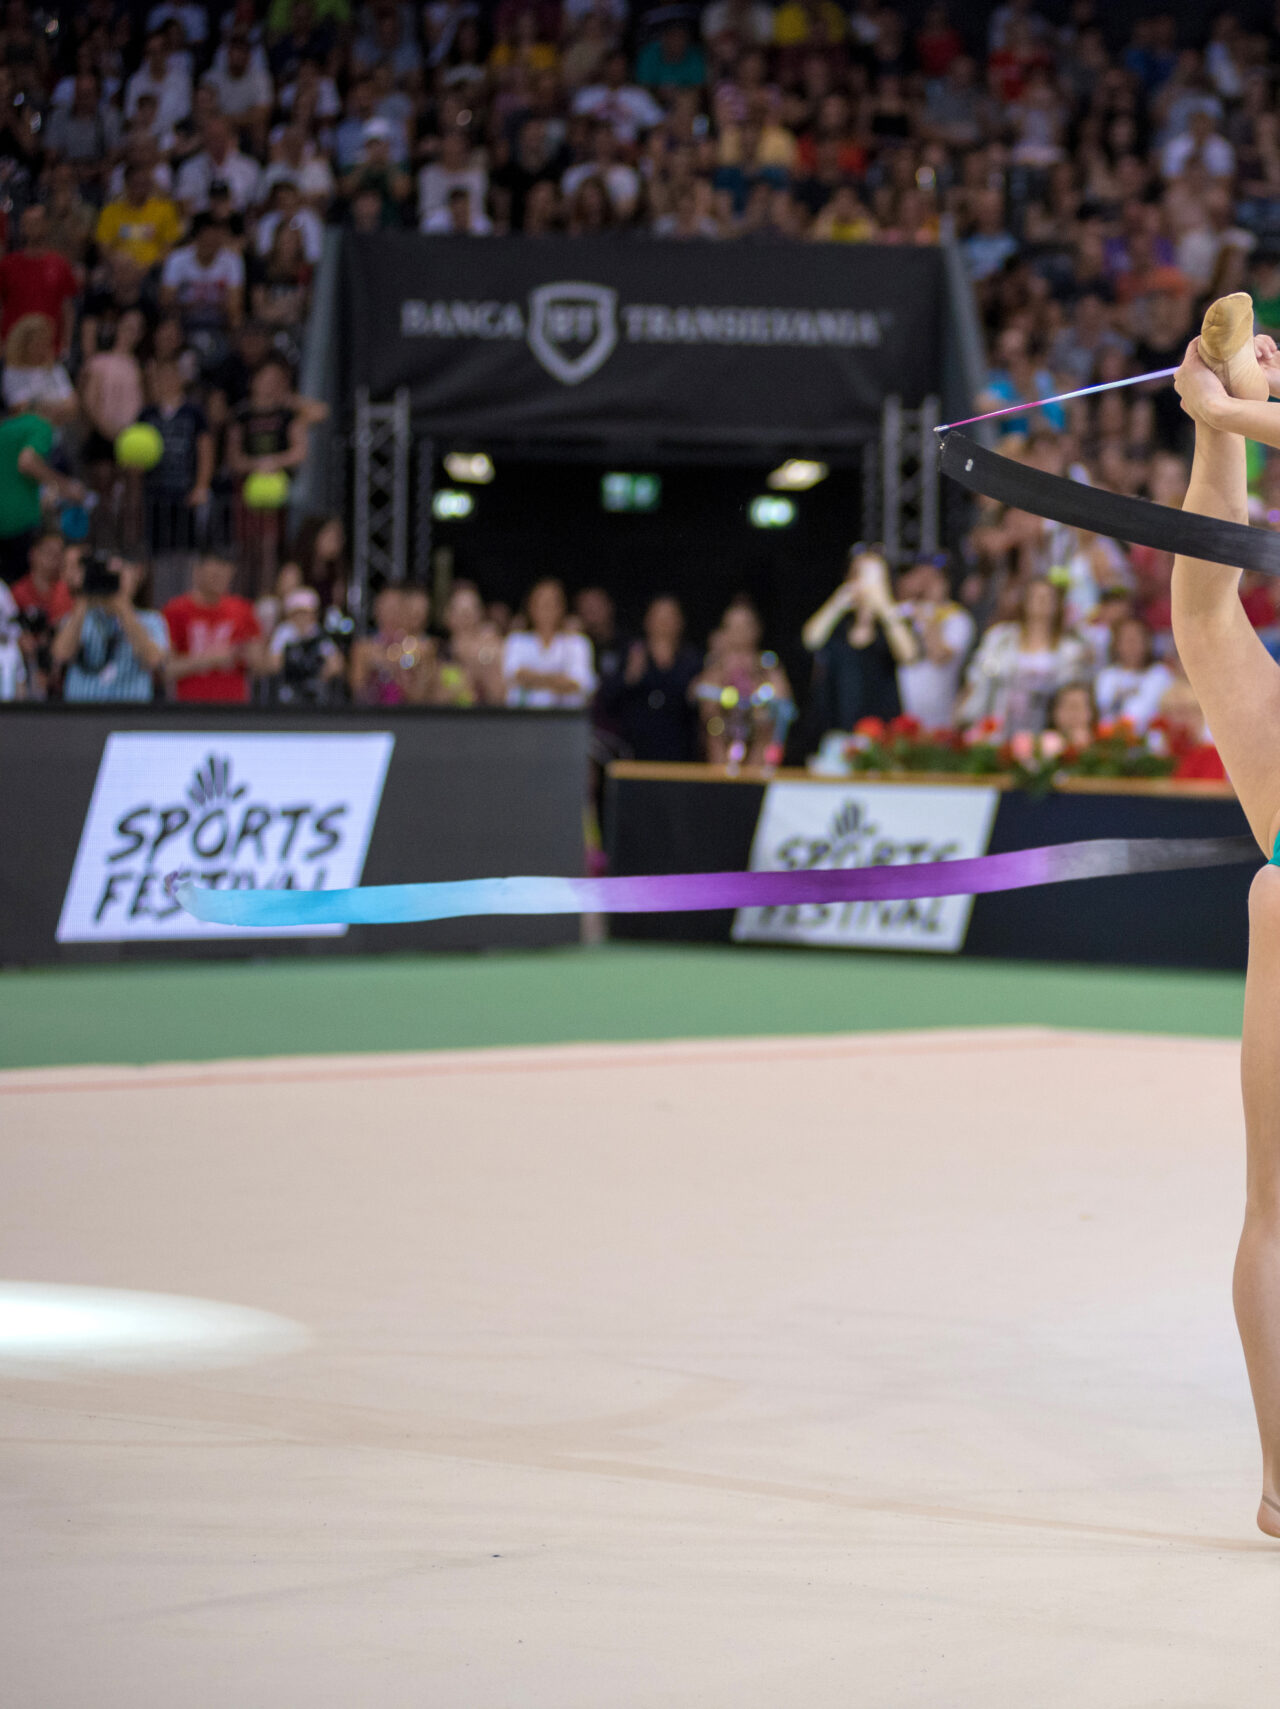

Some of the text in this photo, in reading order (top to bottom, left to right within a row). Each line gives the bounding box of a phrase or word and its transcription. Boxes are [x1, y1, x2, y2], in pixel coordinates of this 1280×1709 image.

[402, 299, 525, 339] BANCA
[621, 304, 883, 347] TRANSILVANIA
[106, 803, 347, 864] SPORTS
